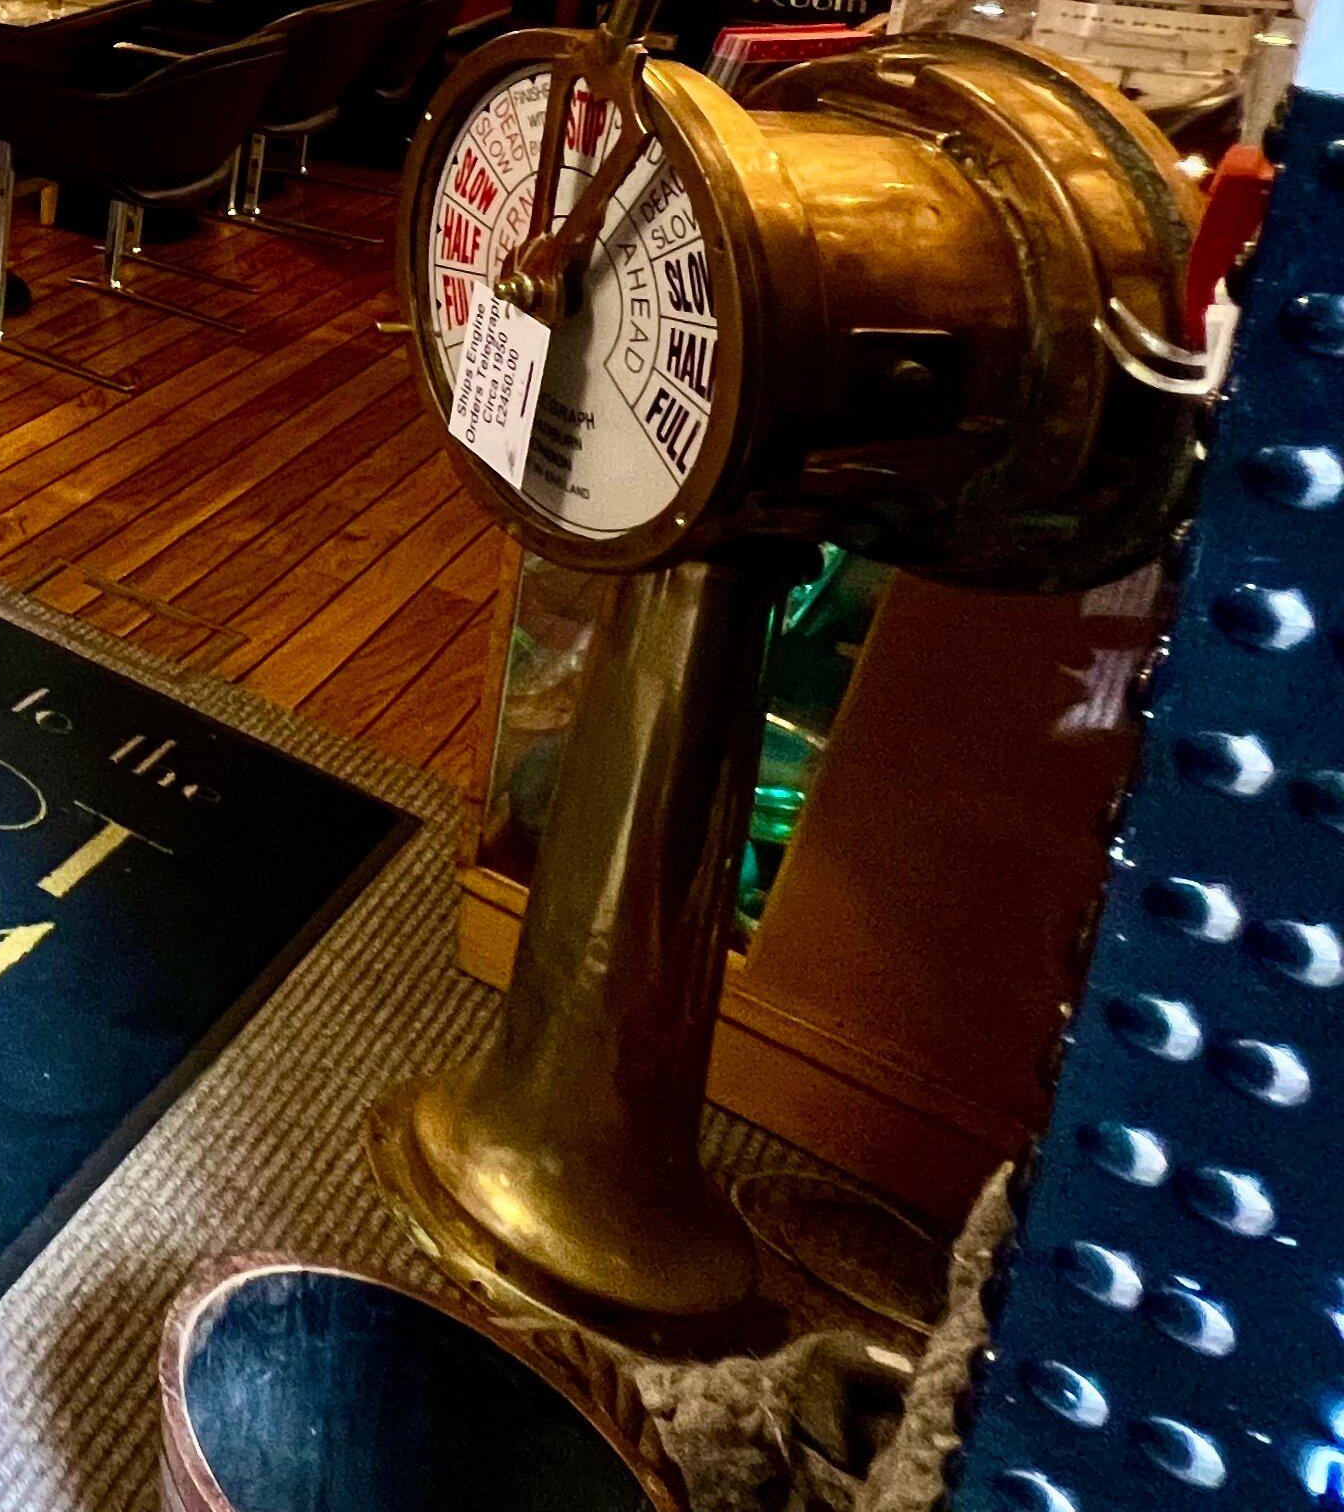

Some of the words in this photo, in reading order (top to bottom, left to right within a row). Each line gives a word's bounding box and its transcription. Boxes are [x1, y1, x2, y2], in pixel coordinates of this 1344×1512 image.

[475, 116, 513, 175] SLOW
[493, 97, 526, 162] DEAD
[454, 147, 499, 216] SLOW
[440, 202, 482, 265] HALF
[616, 241, 652, 375] AHEAD
[457, 370, 474, 418] Ships
[466, 303, 486, 364] Engine
[481, 378, 499, 425] Circa
[493, 331, 509, 373] 1950
[495, 348, 520, 428] £2450.00
[465, 385, 485, 445] Orders
[645, 386, 702, 476] FULL
[12, 687, 76, 736] to
[109, 734, 222, 805] the
